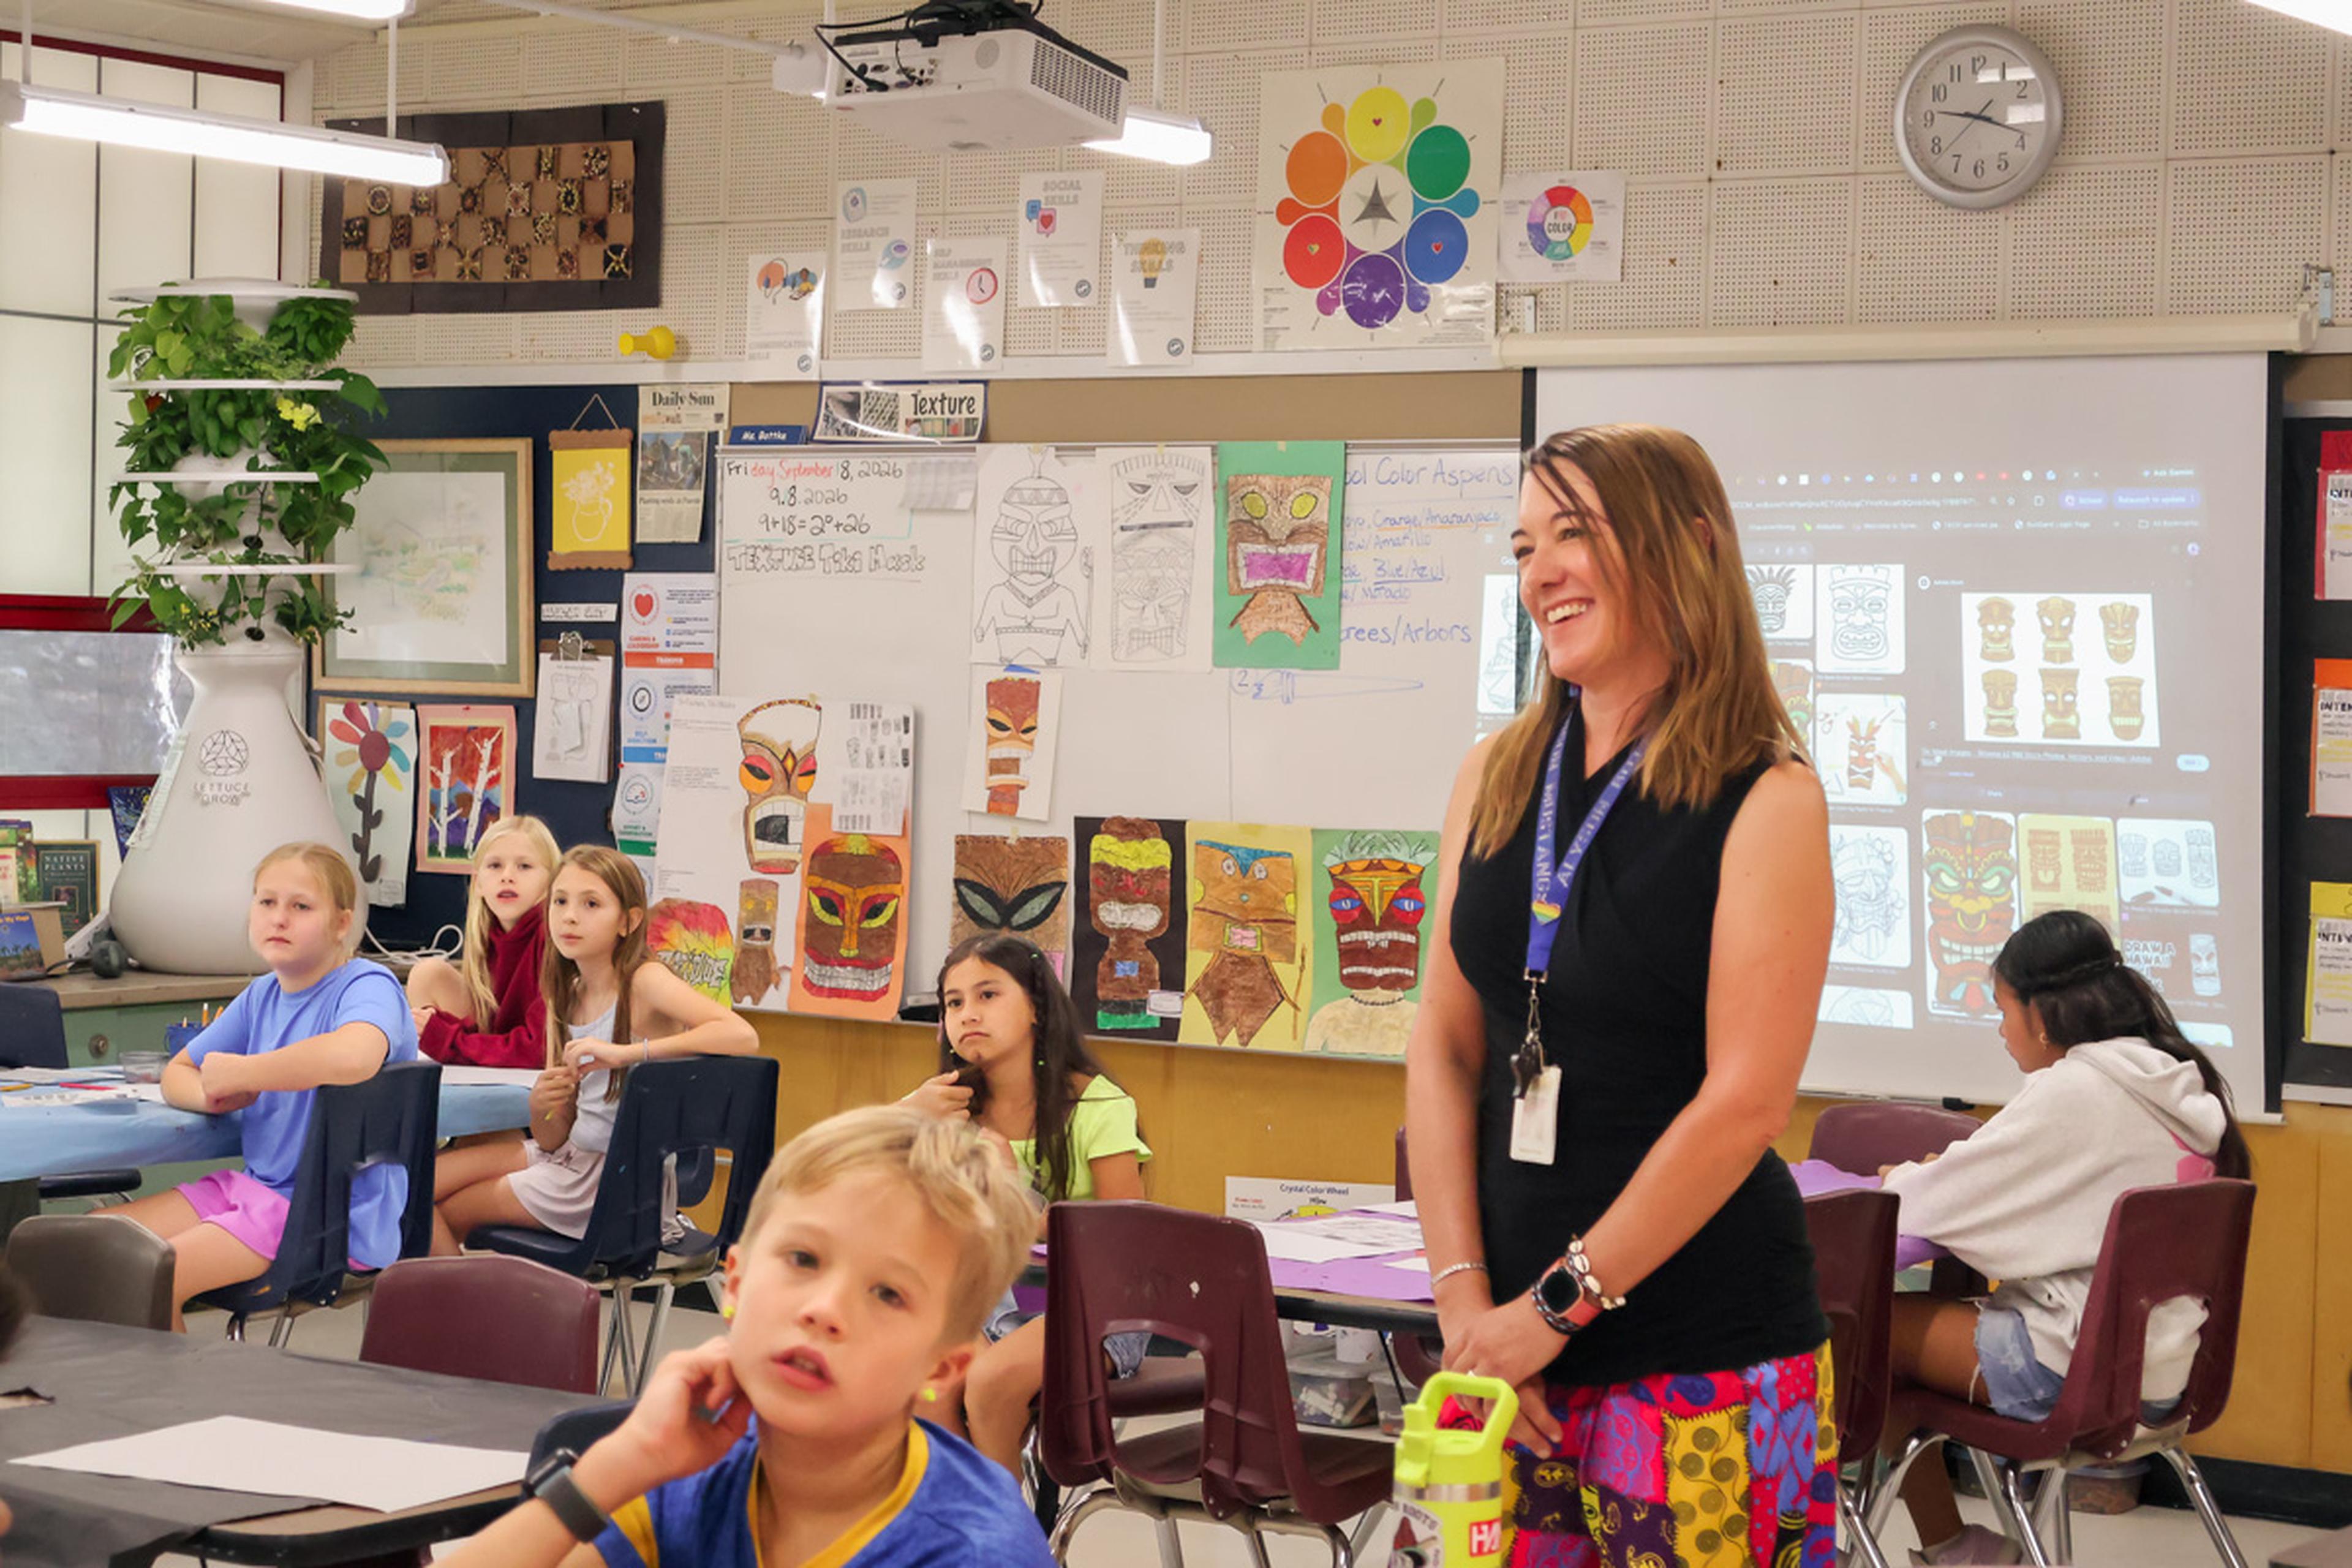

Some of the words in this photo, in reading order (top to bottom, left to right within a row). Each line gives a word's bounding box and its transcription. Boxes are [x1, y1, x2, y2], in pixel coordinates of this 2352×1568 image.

[1950, 65, 1961, 83] 11
[1972, 55, 1986, 75] 12
[2002, 62, 2006, 80] 1
[1932, 84, 1947, 102] 10
[2016, 80, 2027, 99] 2
[1924, 110, 1934, 128] 9
[1931, 136, 1942, 154] 8
[2015, 135, 2026, 151] 4
[1953, 155, 1962, 173] 7
[1973, 160, 1985, 178] 6
[1997, 153, 2009, 171] 5
[1042, 180, 1082, 191] SOCIAL
[1044, 195, 1079, 206] SKILLS
[841, 227, 890, 239] RESEARCH
[1547, 222, 1572, 234] COLOR
[652, 391, 686, 409] Daily
[688, 391, 715, 407] Sun
[912, 391, 976, 417] Texture
[858, 460, 903, 479] 2026
[1375, 456, 1427, 485] Color
[1432, 458, 1513, 499] Aspens
[194, 782, 248, 792] LETTUCE
[200, 794, 241, 804] GROW
[1280, 1183, 1304, 1194] Crystal
[1306, 1184, 1324, 1194] Color
[1327, 1186, 1349, 1195] Wheel
